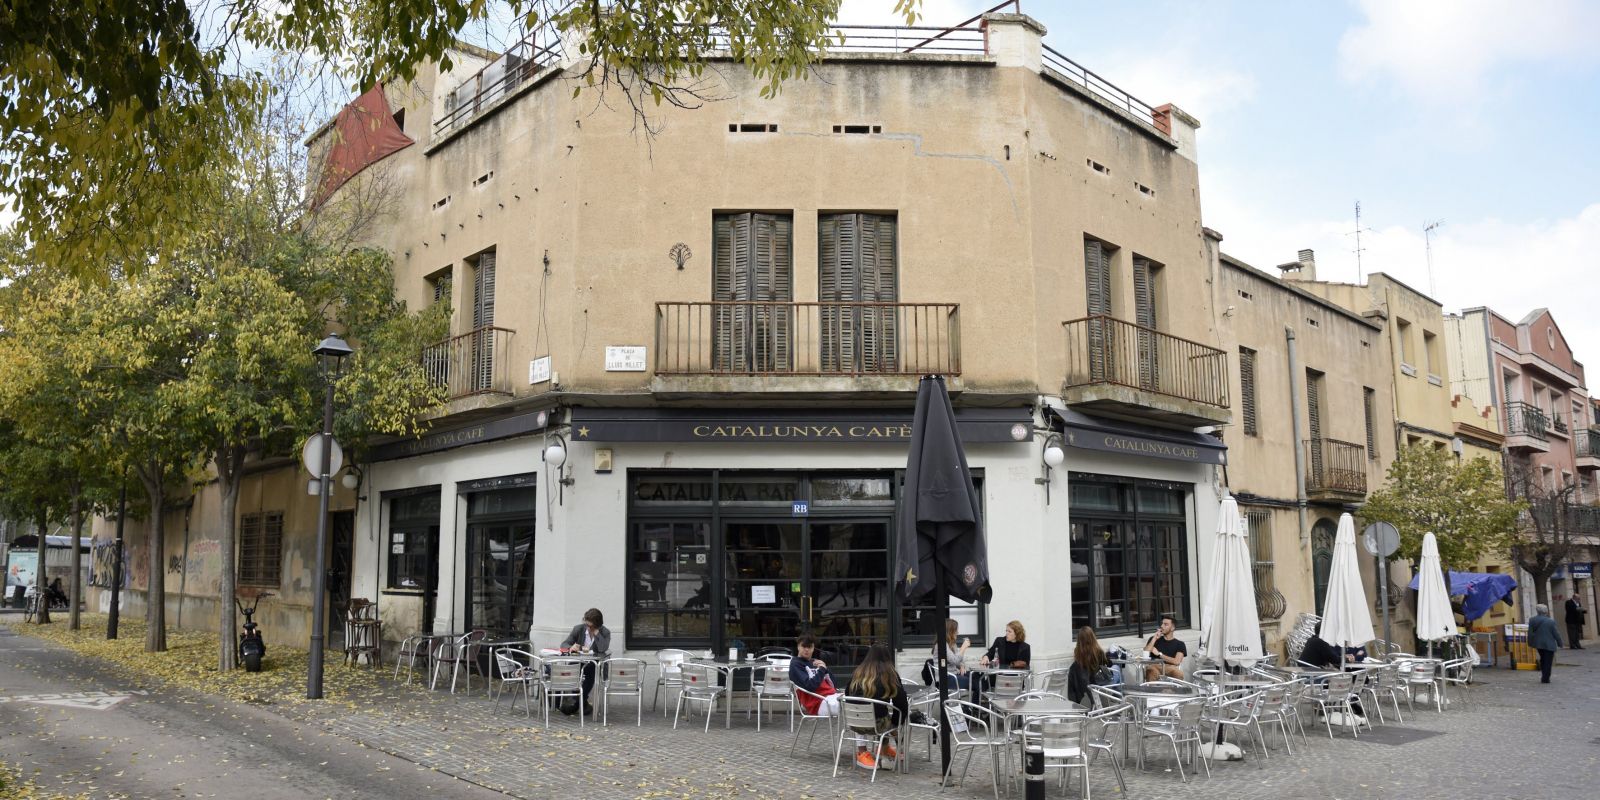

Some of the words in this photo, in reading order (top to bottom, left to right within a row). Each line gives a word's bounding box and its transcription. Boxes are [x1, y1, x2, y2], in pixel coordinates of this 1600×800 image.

[625, 361, 643, 369] MILLET
[693, 426, 843, 437] CATALUNYA
[1104, 436, 1171, 455] CATALUNYA
[757, 482, 797, 501] BAR
[793, 504, 808, 513] RB
